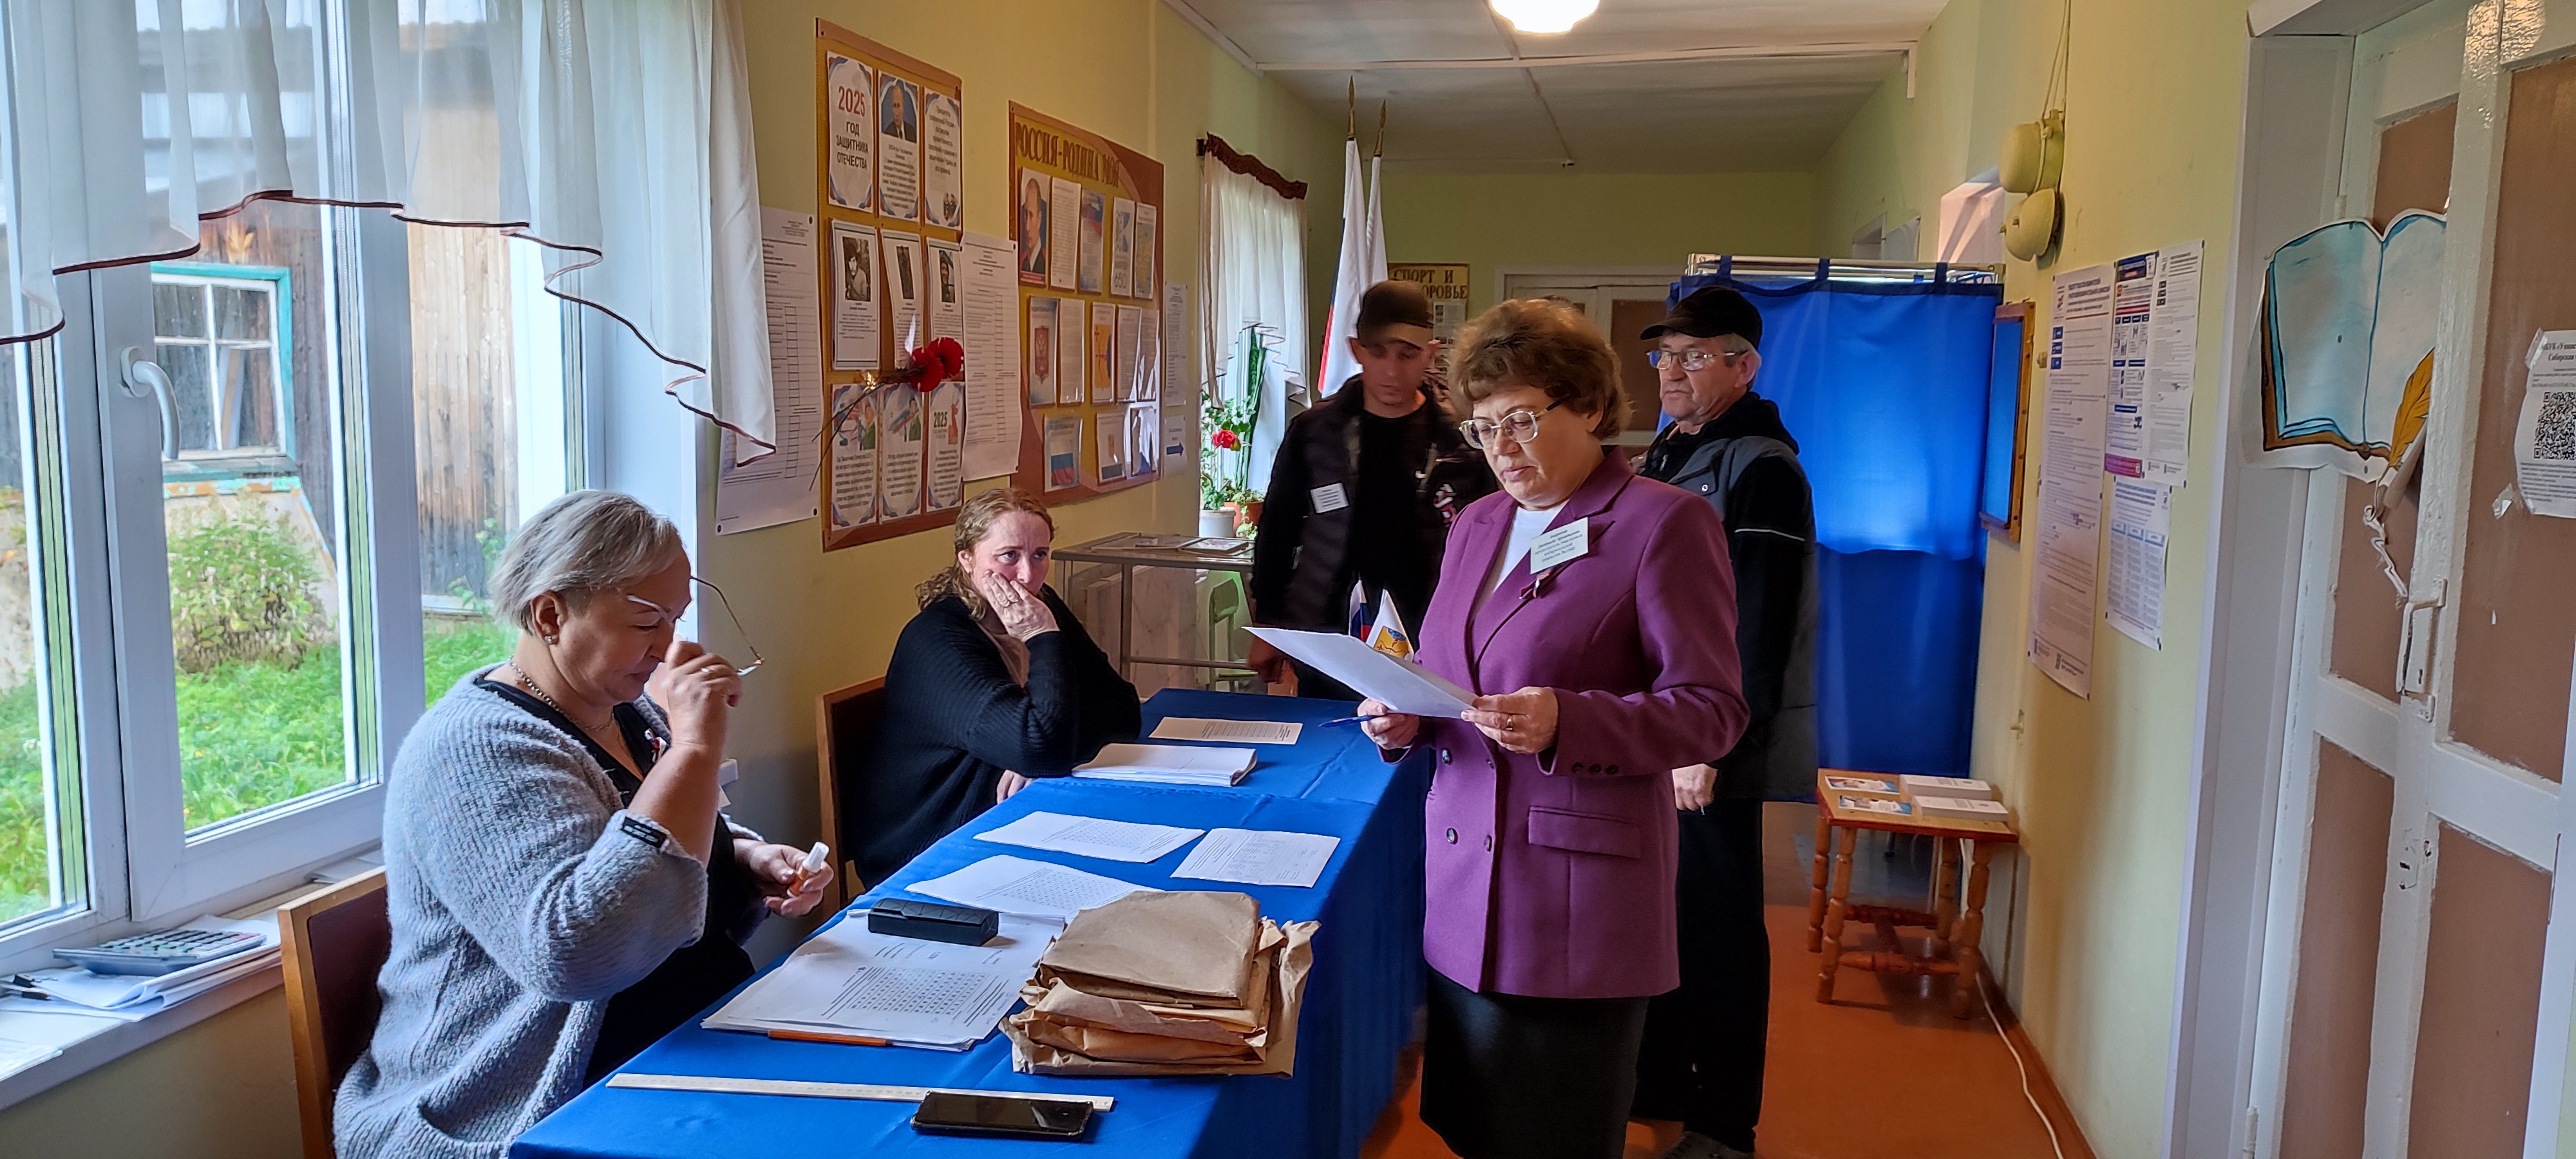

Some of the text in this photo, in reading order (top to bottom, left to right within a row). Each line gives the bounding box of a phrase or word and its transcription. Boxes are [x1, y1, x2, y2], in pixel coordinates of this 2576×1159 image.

[838, 86, 866, 117] 2025
[846, 121, 860, 137] ГОД
[836, 135, 869, 155] ЗАЩИТНИКА
[837, 151, 867, 171] ОТЕЧЕСТВА
[1103, 155, 1120, 188] МОЯ
[1394, 269, 1454, 283] СПОРТ И
[1421, 285, 1468, 299] ОРОВЬЕ
[933, 411, 948, 428] 2025
